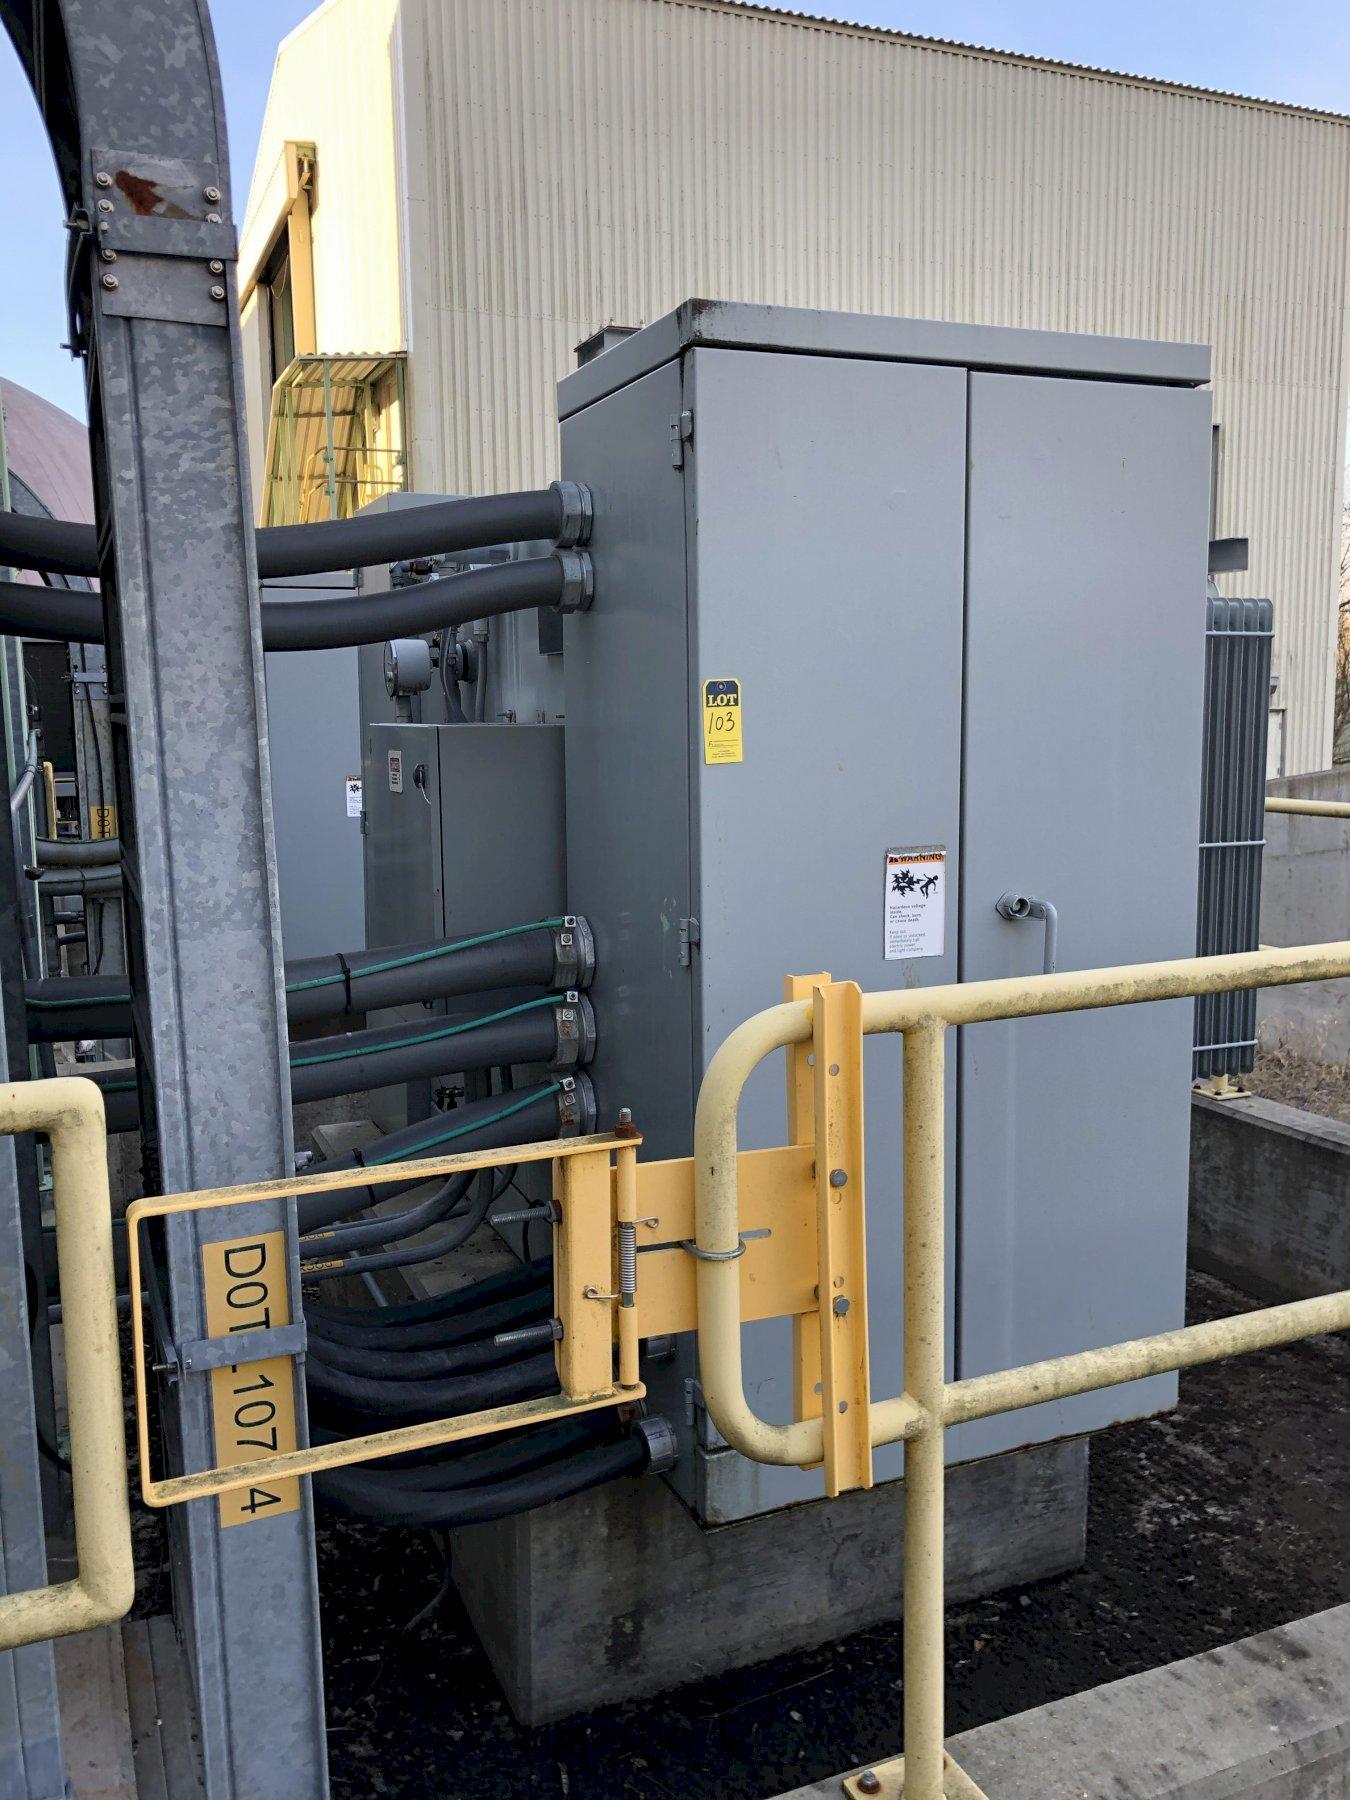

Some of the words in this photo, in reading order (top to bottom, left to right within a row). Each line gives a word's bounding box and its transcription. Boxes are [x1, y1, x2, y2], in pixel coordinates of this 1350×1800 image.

[707, 694, 737, 706] LOT
[708, 711, 735, 734] 103
[900, 853, 942, 863] WARNING
